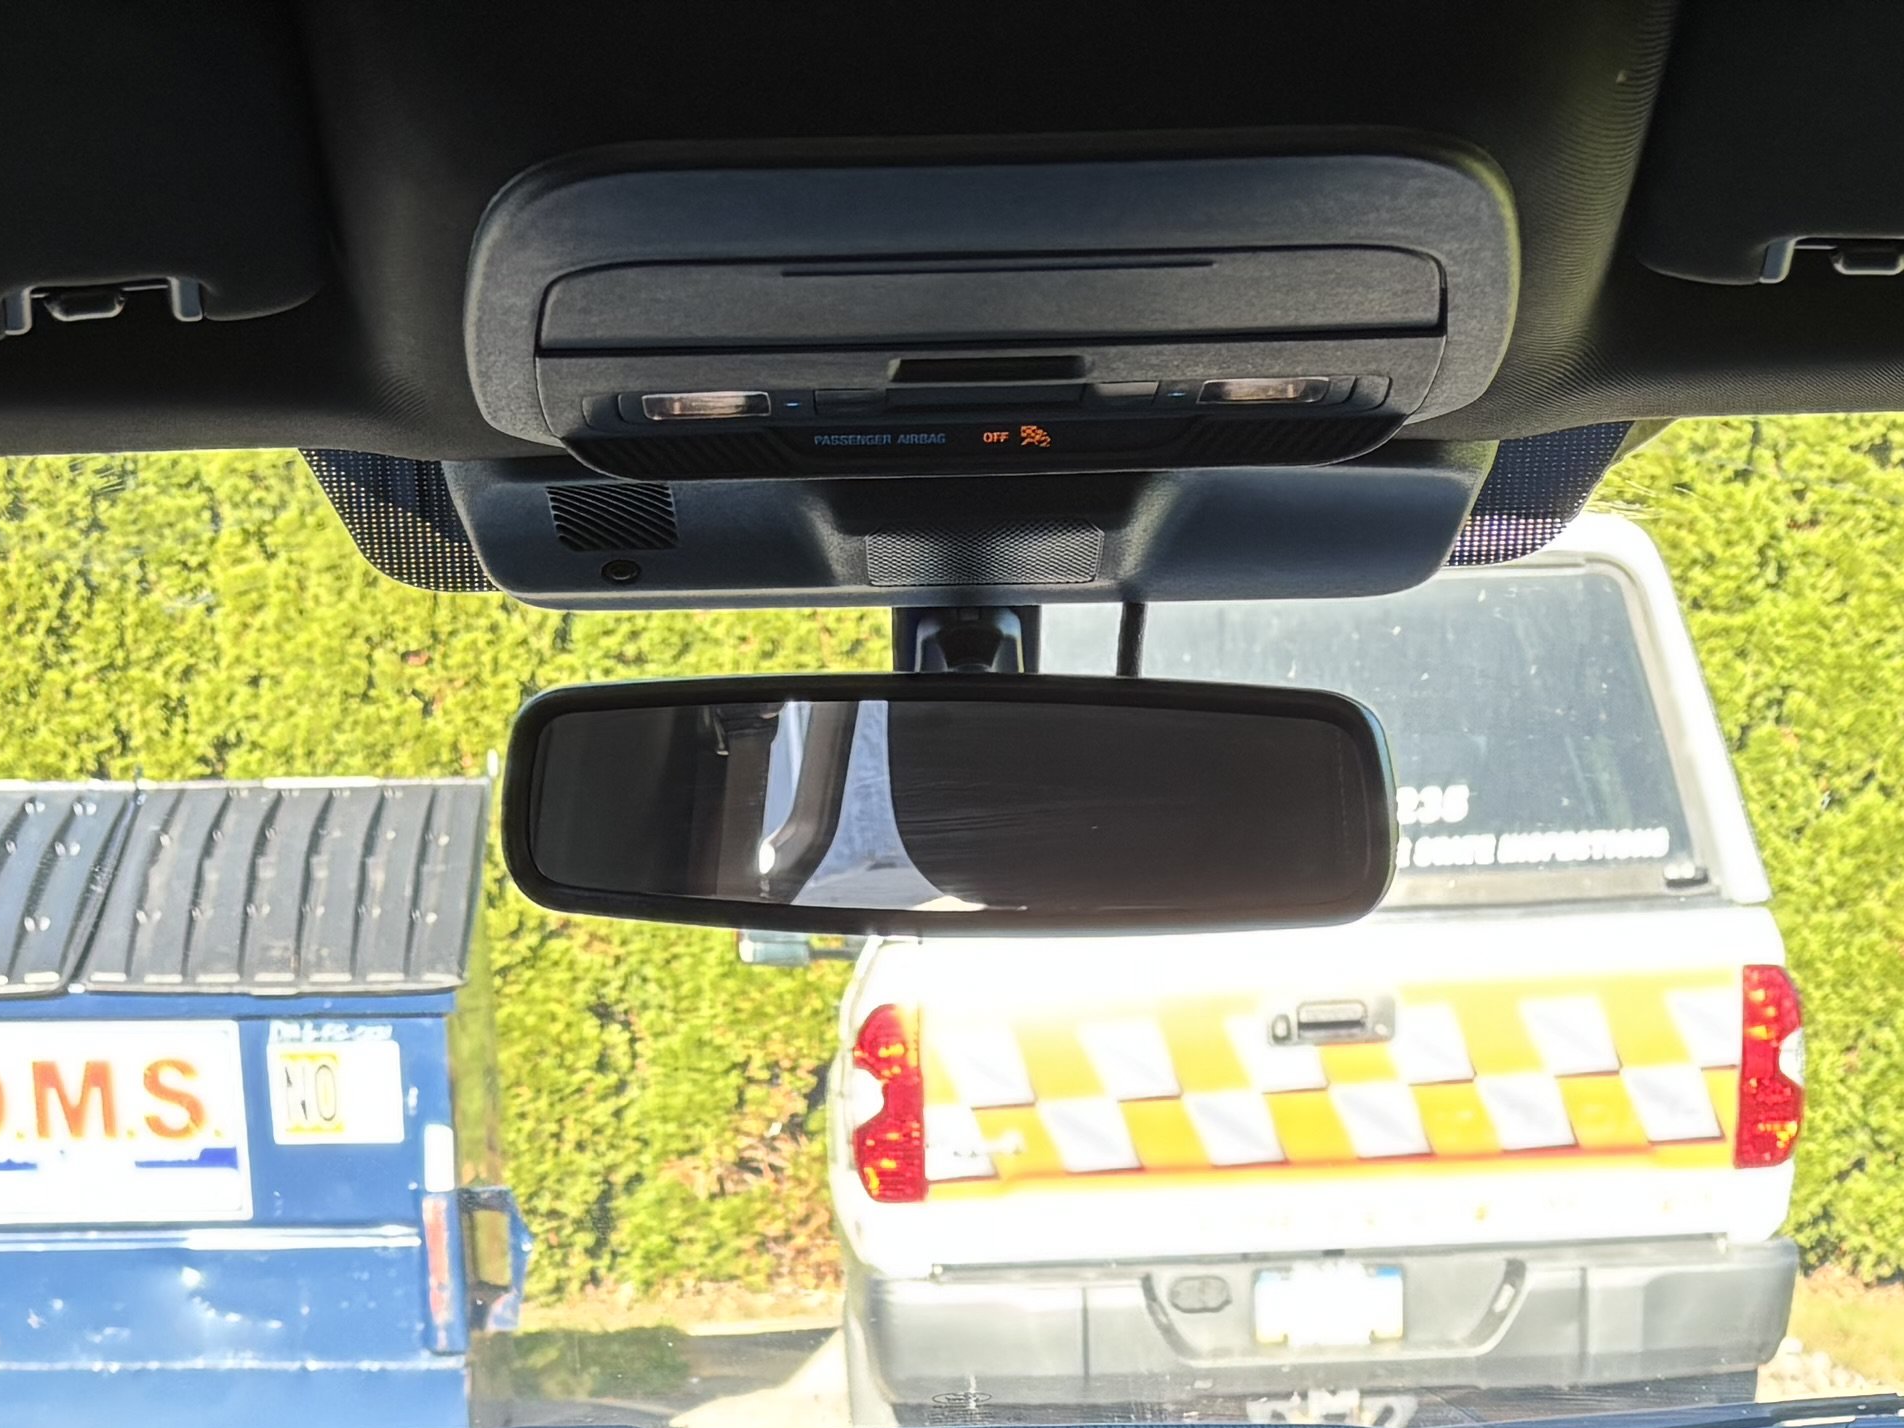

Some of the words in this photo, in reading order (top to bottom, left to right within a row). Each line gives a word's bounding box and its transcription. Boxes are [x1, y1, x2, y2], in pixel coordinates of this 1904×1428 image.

[814, 434, 891, 446] PASSENGER
[897, 432, 946, 445] AIRBAG
[982, 431, 1010, 444] OFF
